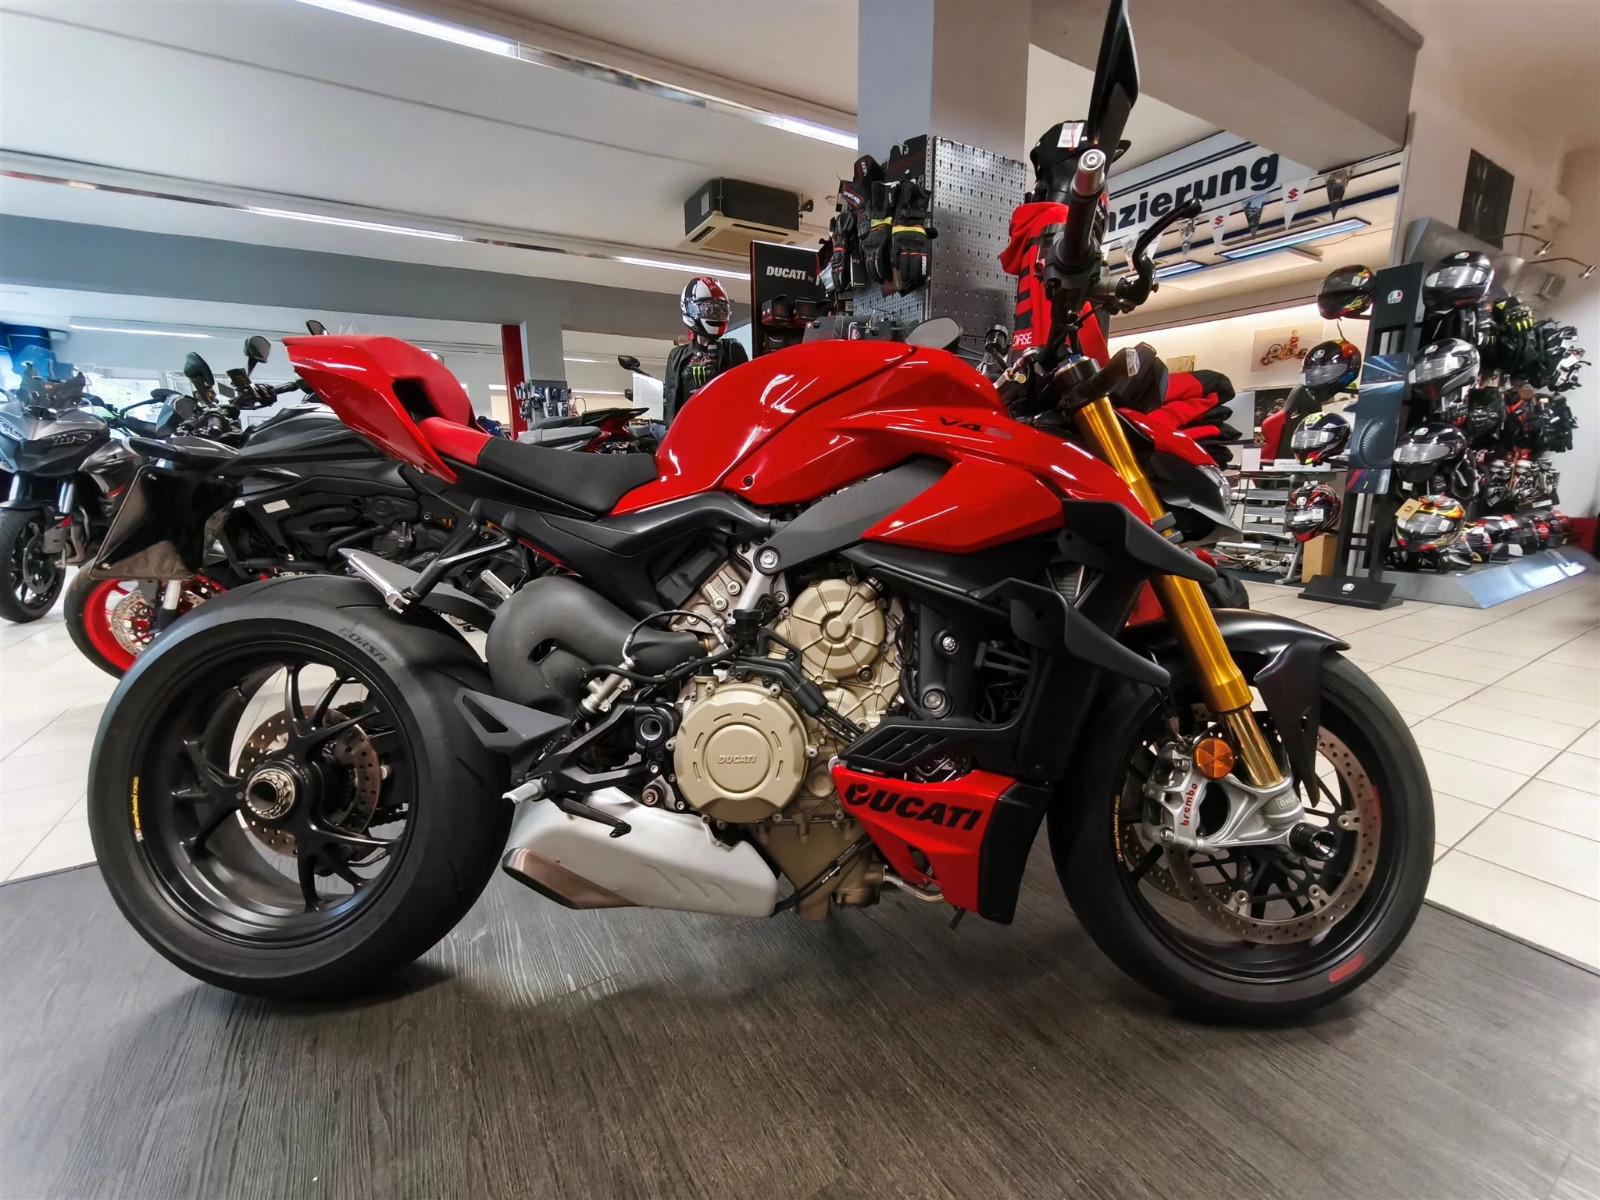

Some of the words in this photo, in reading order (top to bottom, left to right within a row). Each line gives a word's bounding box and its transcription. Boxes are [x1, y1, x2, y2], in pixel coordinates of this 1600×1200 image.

[766, 265, 807, 280] DUCATI
[718, 754, 758, 765] DUCATI
[844, 783, 984, 832] DUCATI
[1180, 783, 1198, 827] brembo
